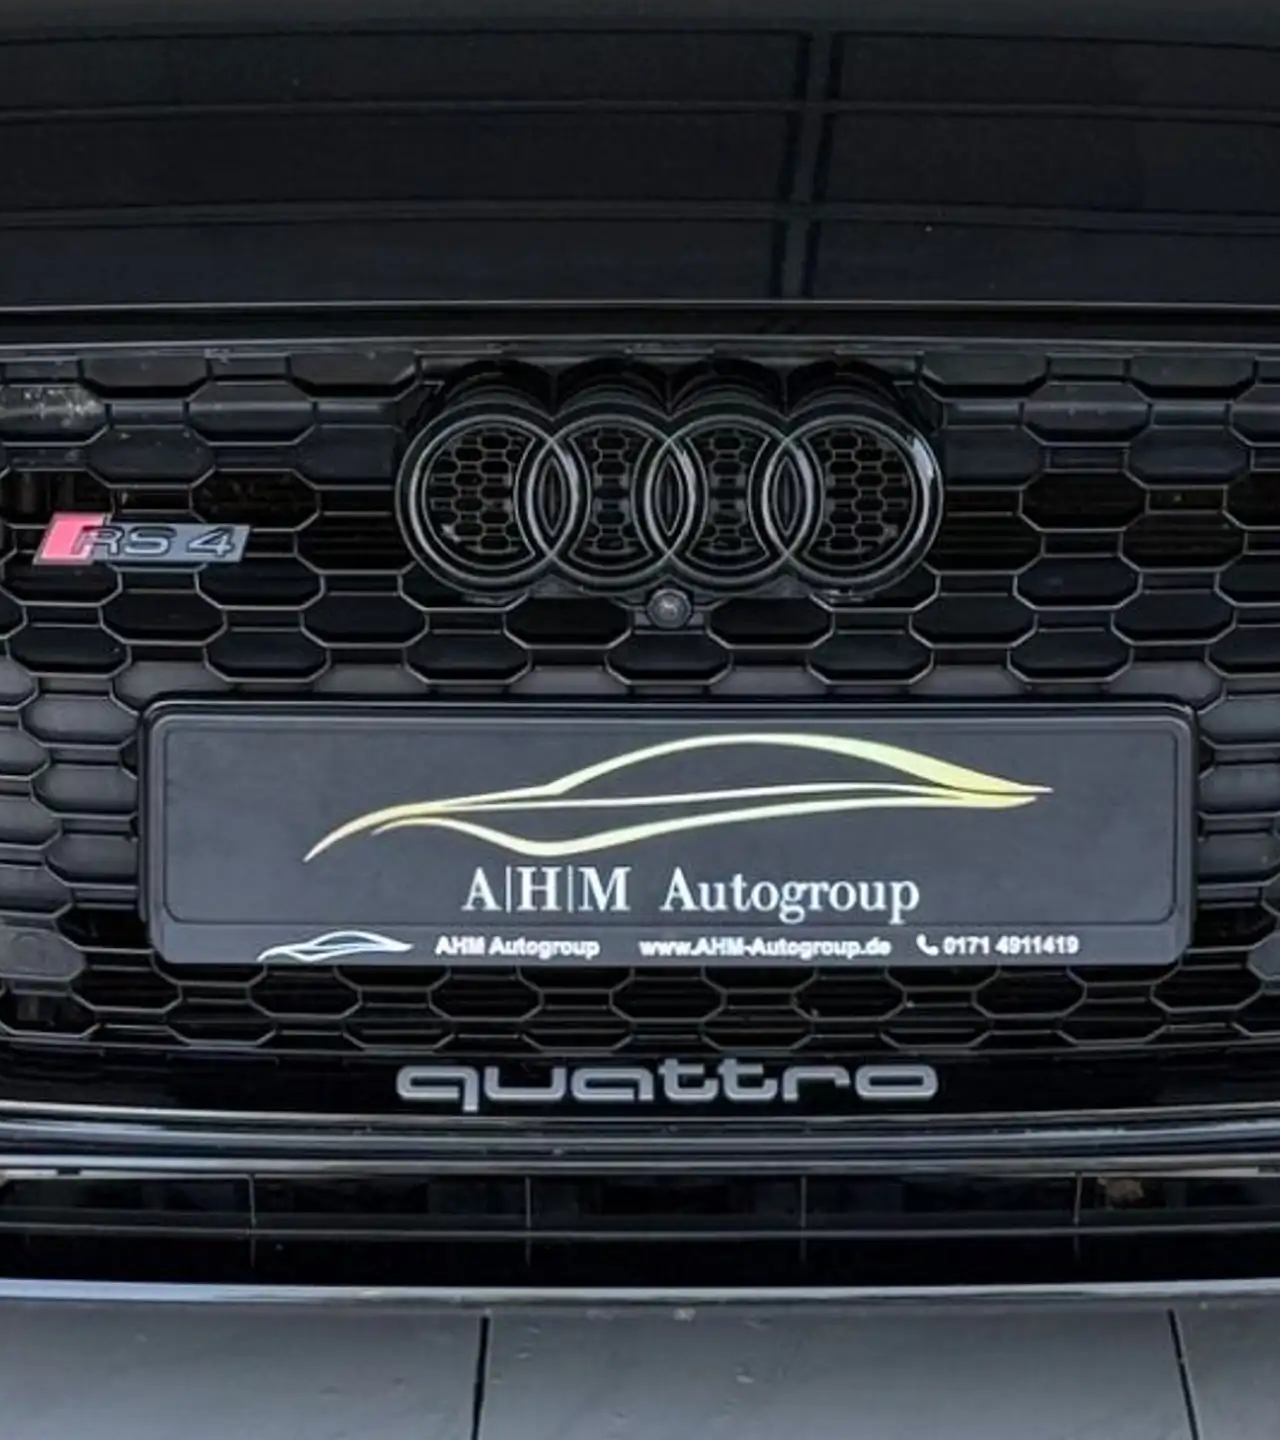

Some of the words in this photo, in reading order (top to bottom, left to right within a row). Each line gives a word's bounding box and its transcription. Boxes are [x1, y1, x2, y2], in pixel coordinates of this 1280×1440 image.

[72, 525, 176, 556] RS
[187, 525, 235, 557] 4
[660, 867, 920, 923] Autogroup
[436, 935, 487, 957] AHM
[490, 935, 600, 959] Autogroup
[639, 935, 892, 959] www.AHM-Autogroup.de
[944, 935, 991, 955] 0171
[995, 935, 1080, 955] 4911419
[396, 1060, 939, 1112] quattro
